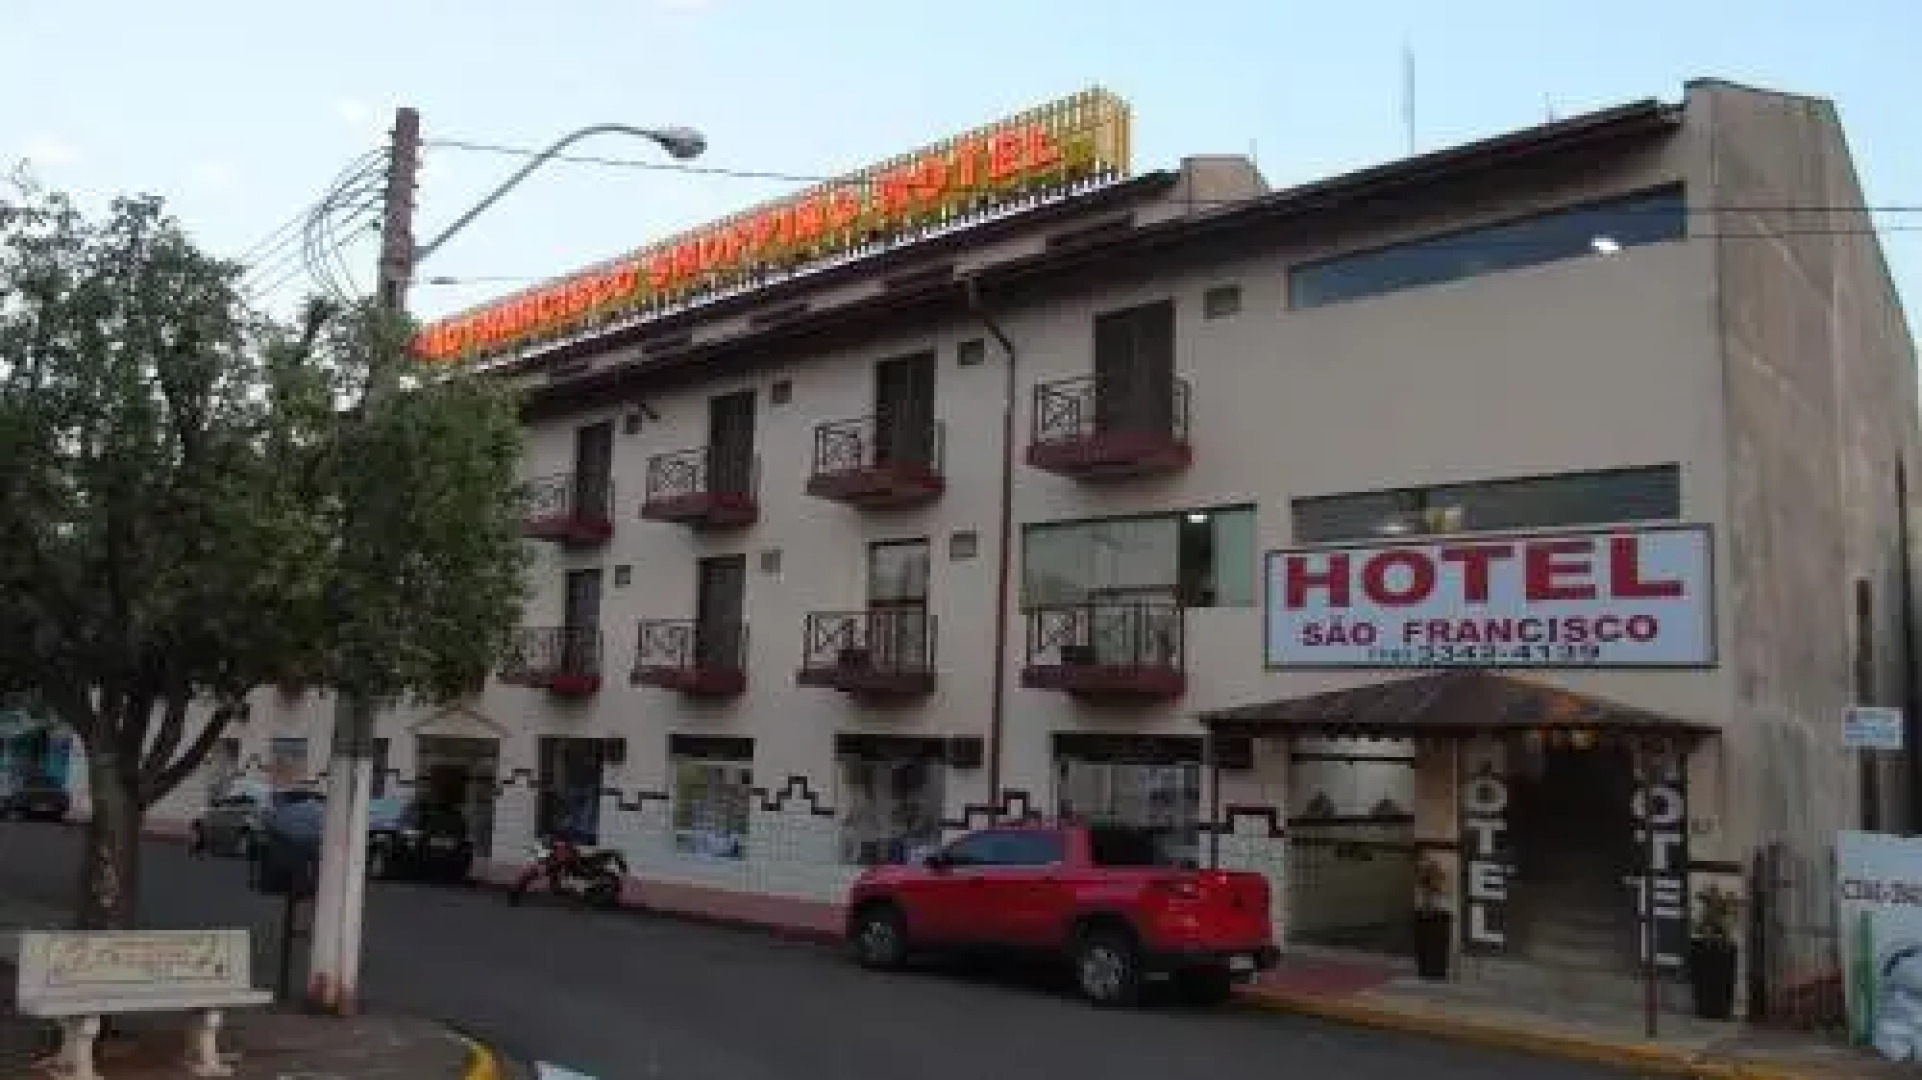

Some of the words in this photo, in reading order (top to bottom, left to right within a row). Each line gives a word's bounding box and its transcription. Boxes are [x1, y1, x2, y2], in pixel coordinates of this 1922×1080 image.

[880, 122, 1064, 214] HOTEL
[1286, 532, 1685, 608] HOTEL
[1302, 617, 1377, 646] SÃO
[1402, 614, 1660, 643] FRANCISCO
